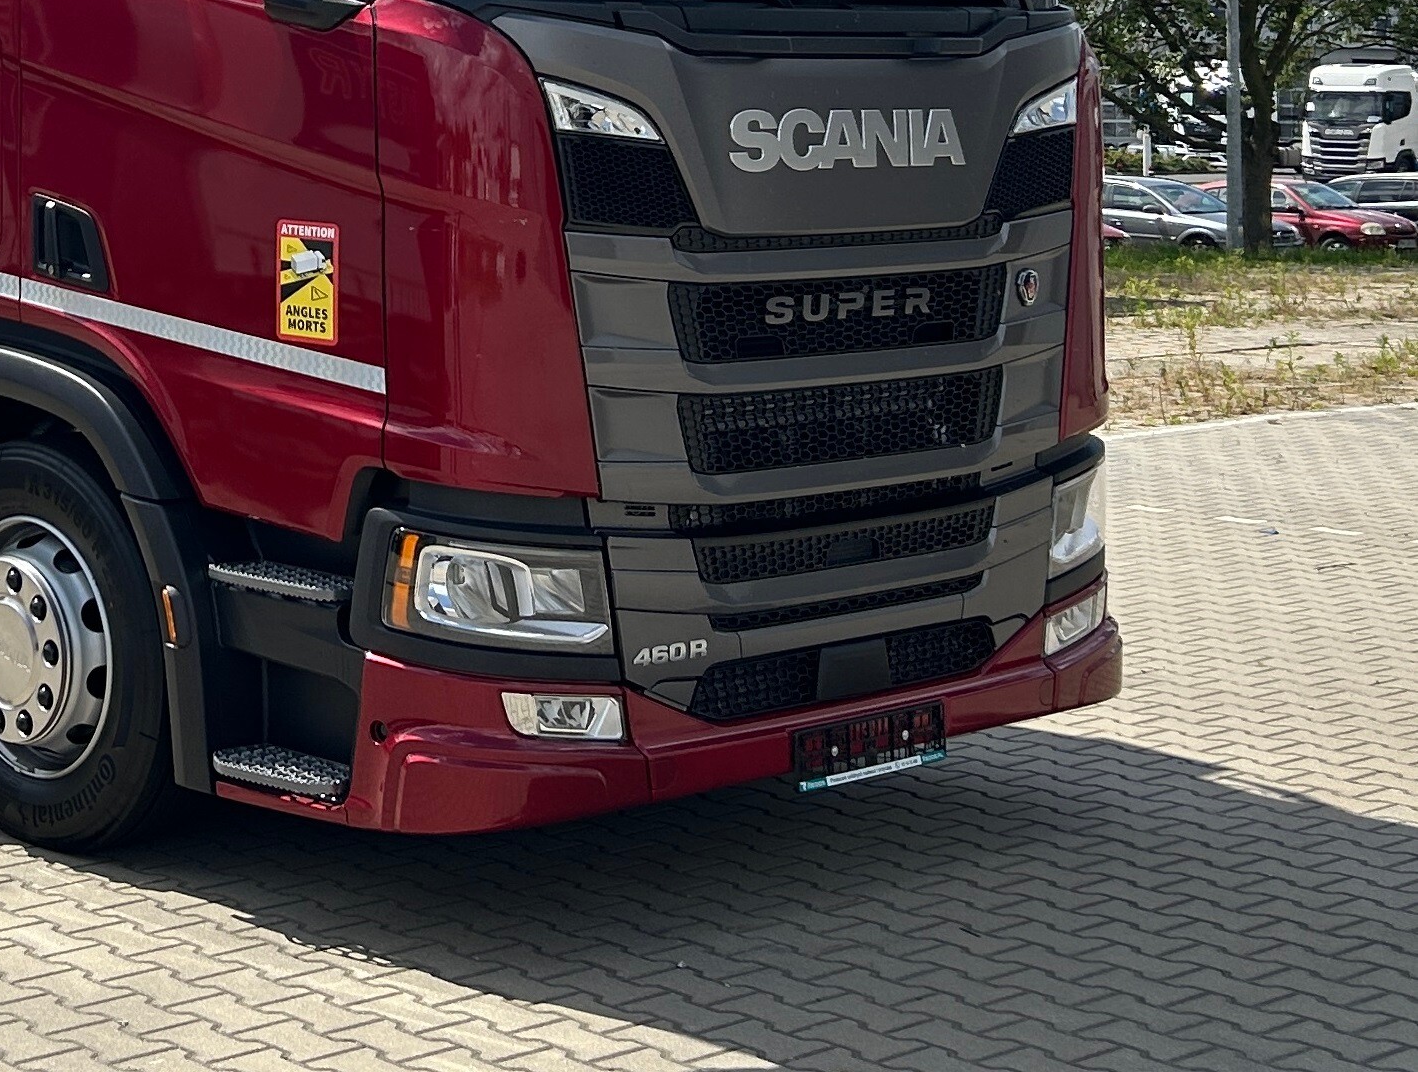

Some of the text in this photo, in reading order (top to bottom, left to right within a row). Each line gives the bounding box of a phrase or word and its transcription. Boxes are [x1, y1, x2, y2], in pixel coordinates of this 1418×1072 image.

[728, 108, 967, 173] SCANIA
[280, 223, 336, 239] ATTENTION
[285, 304, 329, 321] ANGLES
[764, 287, 931, 325] SUPER
[287, 318, 327, 334] MORTS
[33, 753, 117, 828] Continental
